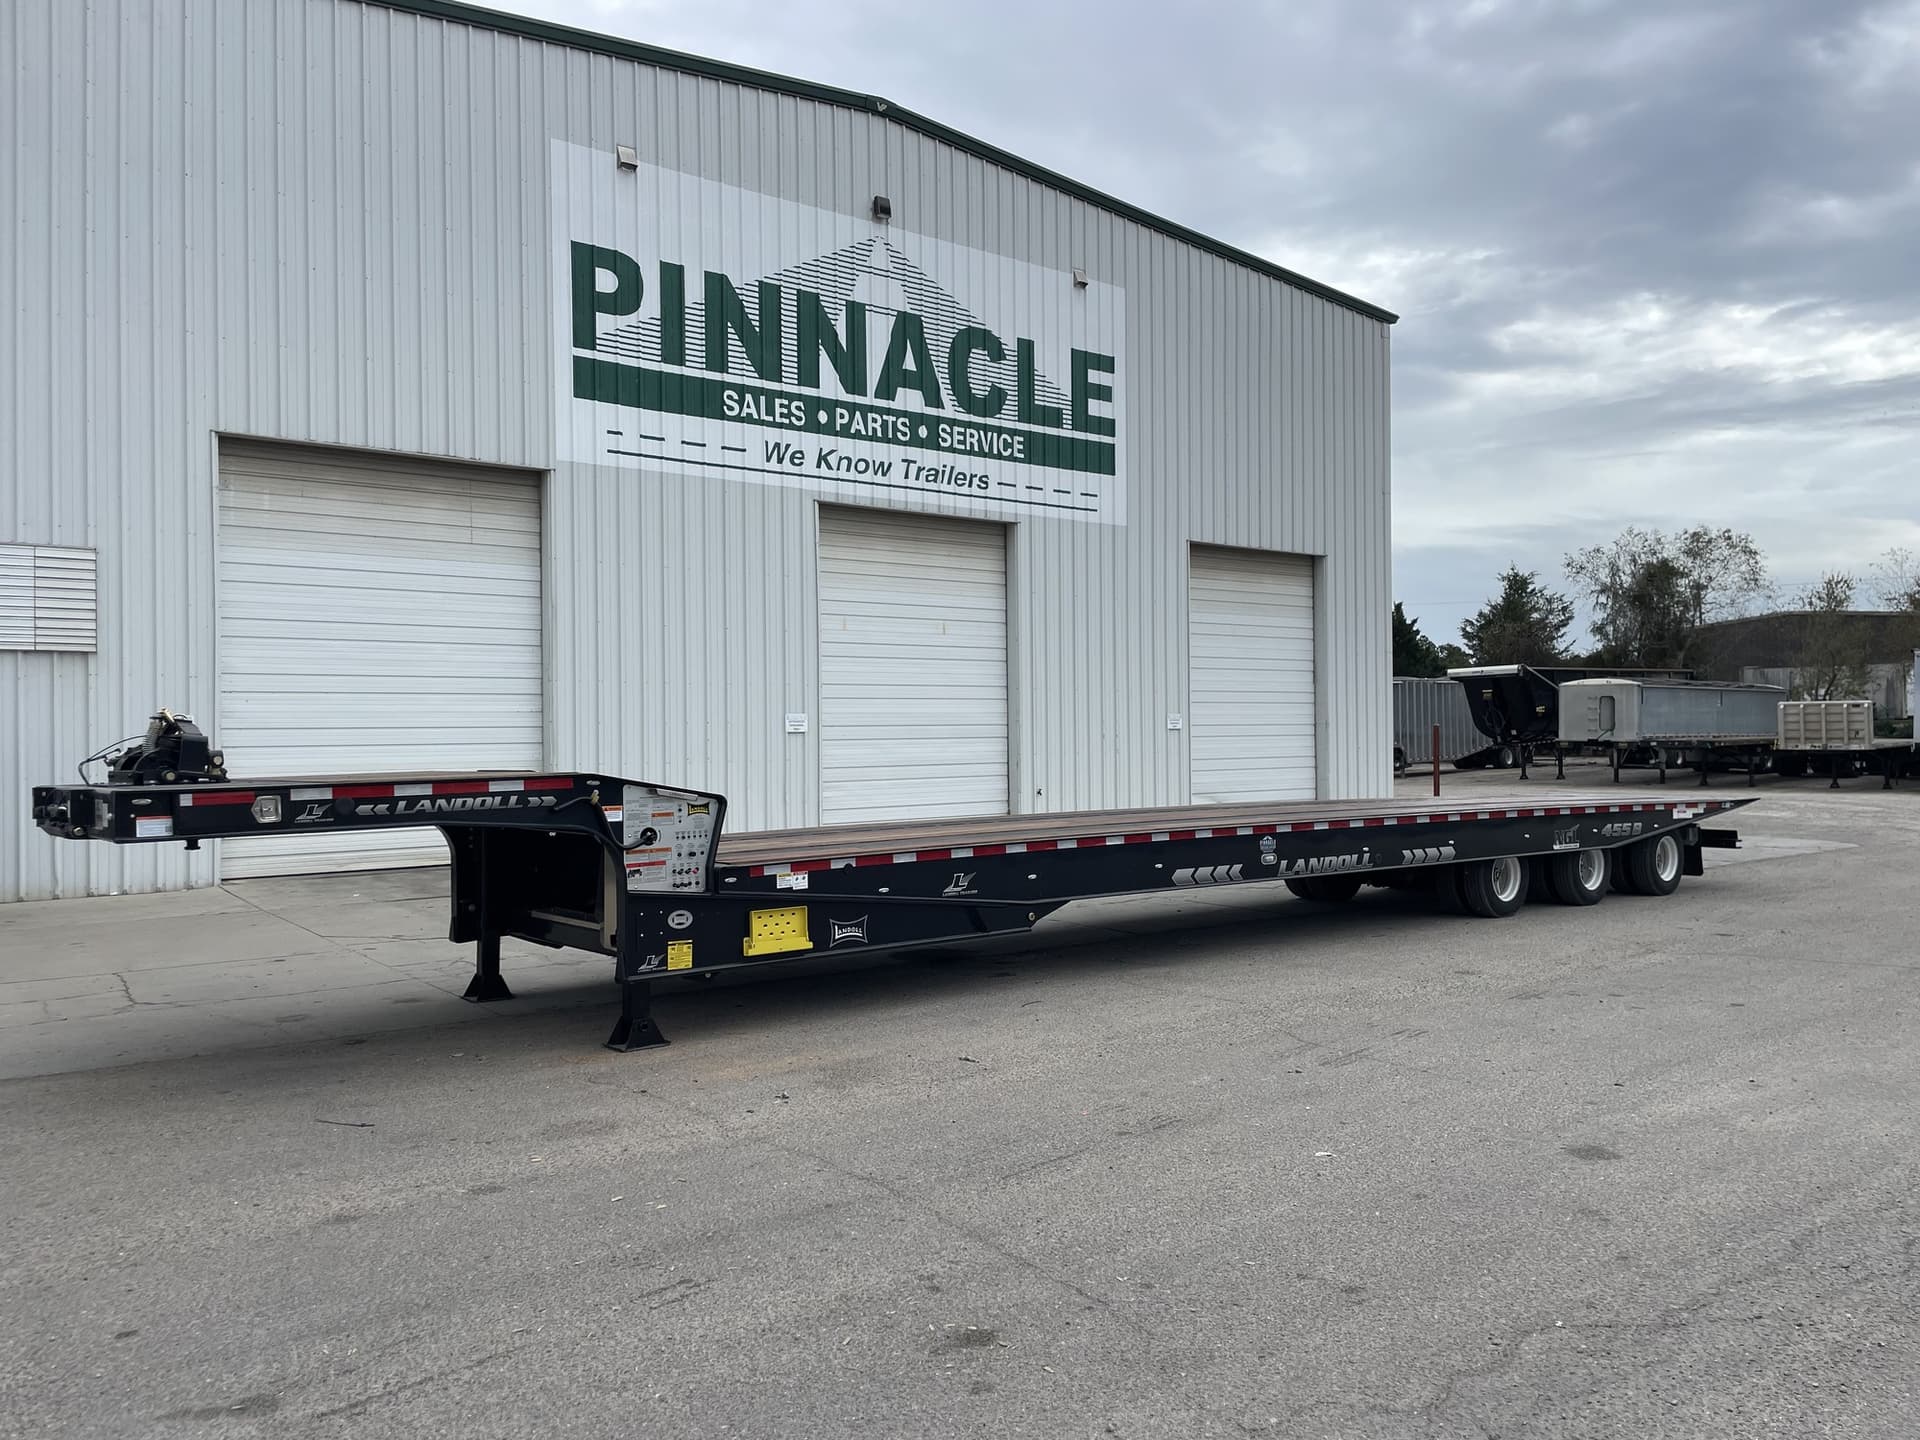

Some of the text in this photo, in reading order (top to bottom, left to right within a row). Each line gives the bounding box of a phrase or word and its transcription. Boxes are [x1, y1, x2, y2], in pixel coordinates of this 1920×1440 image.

[570, 240, 1116, 437] PINNACLE
[722, 390, 1025, 459] SALES PARTS SERVICE
[764, 440, 990, 490] We Know Trailers
[395, 795, 524, 815] LANDOLL
[1278, 853, 1374, 876] LANDOLL
